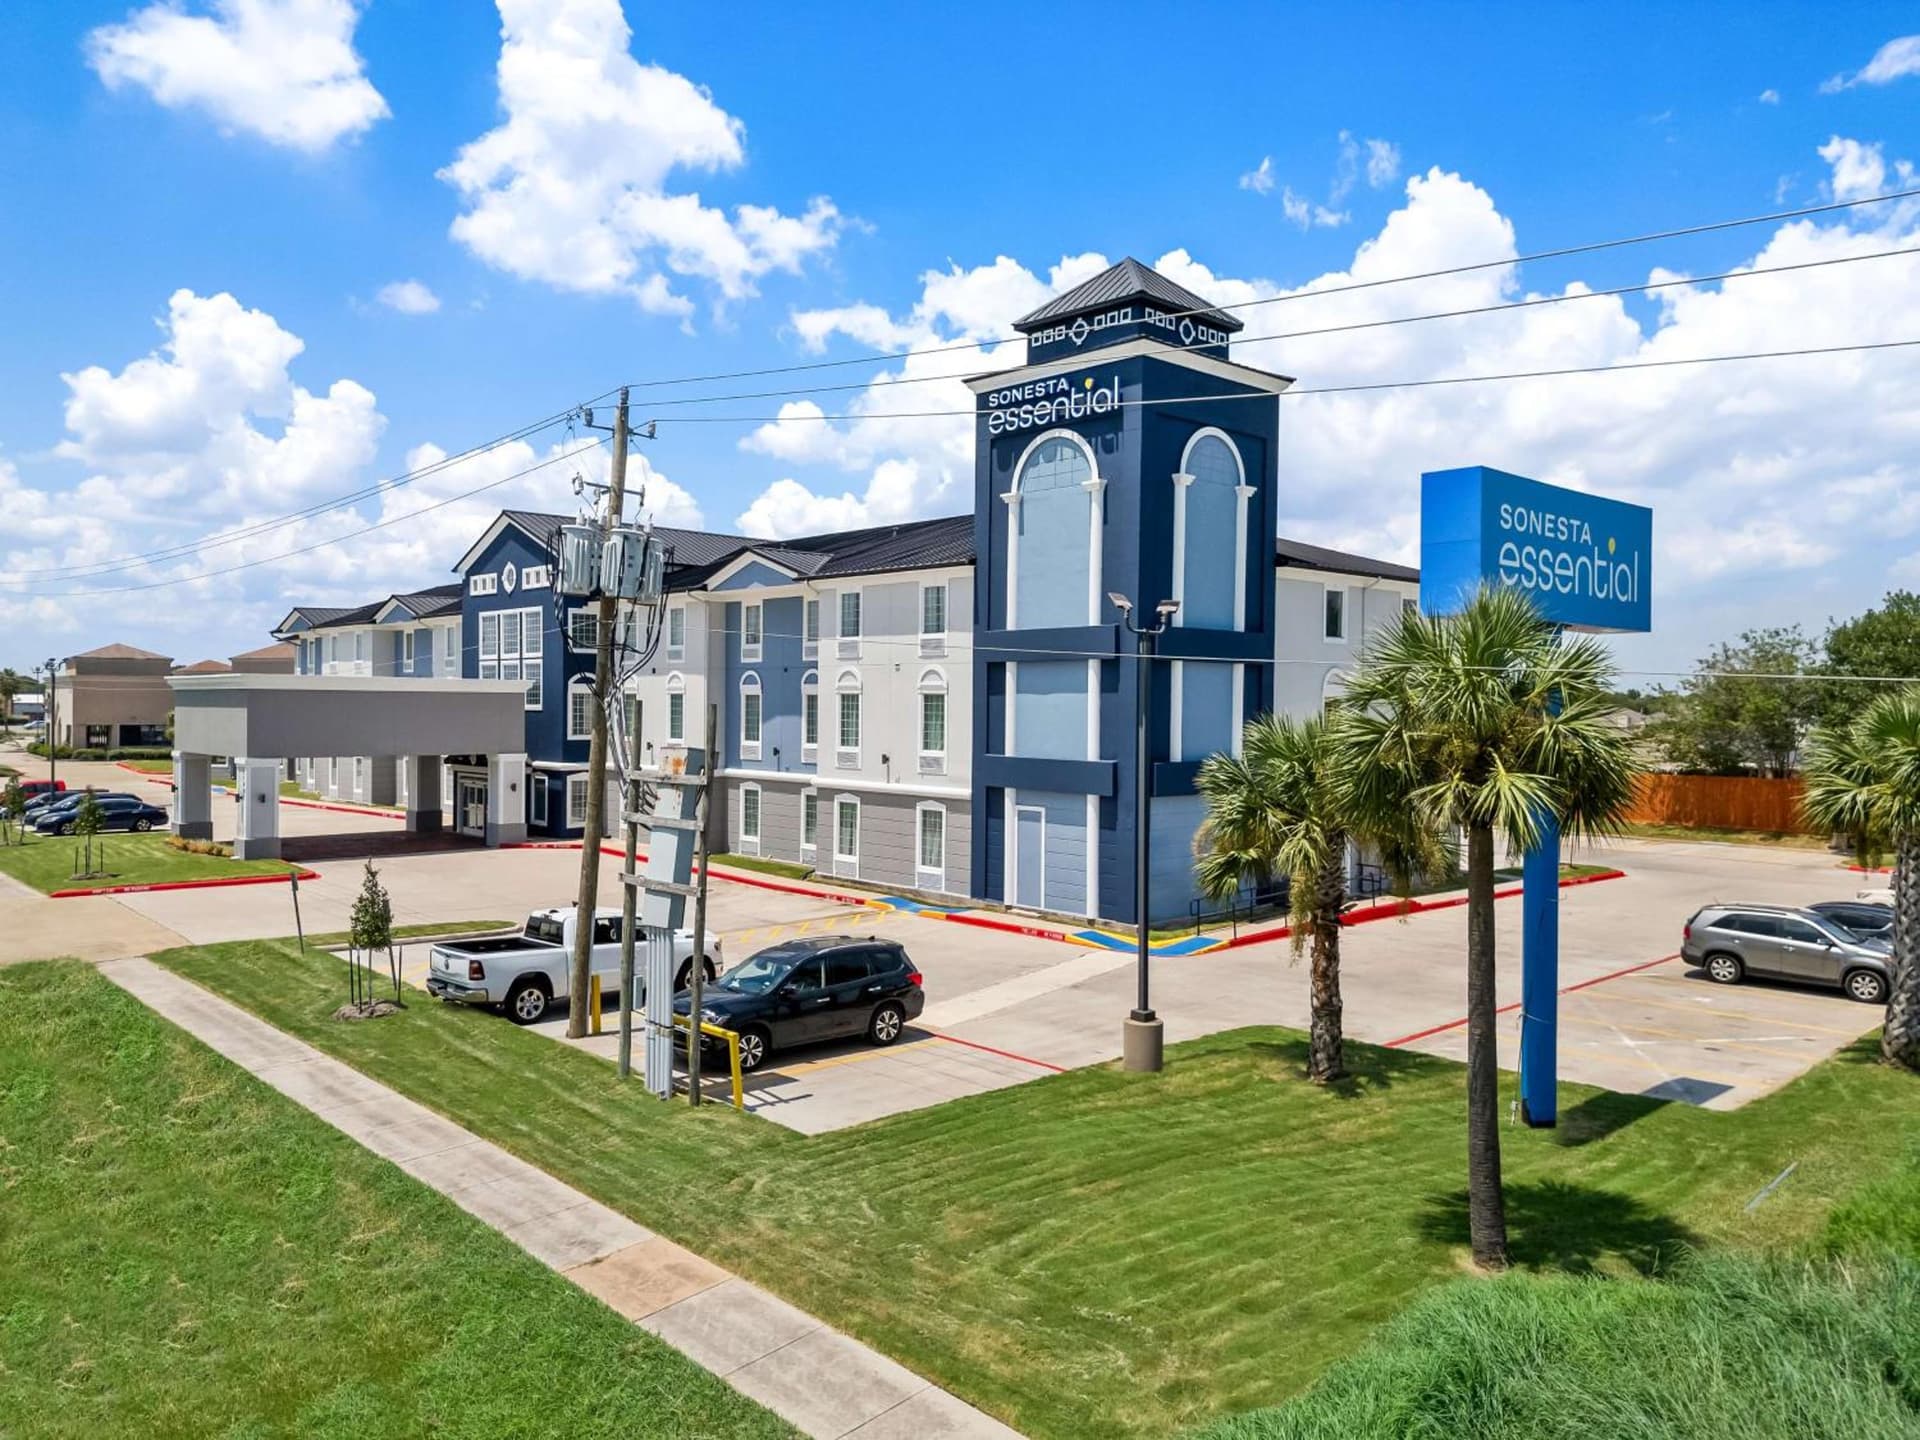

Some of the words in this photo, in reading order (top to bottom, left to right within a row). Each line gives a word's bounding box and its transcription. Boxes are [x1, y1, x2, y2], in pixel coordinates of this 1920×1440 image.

[989, 377, 1069, 407] SONESTA
[989, 375, 1119, 434] essential
[1500, 503, 1592, 545] SONESTA
[1499, 537, 1638, 602] essential
